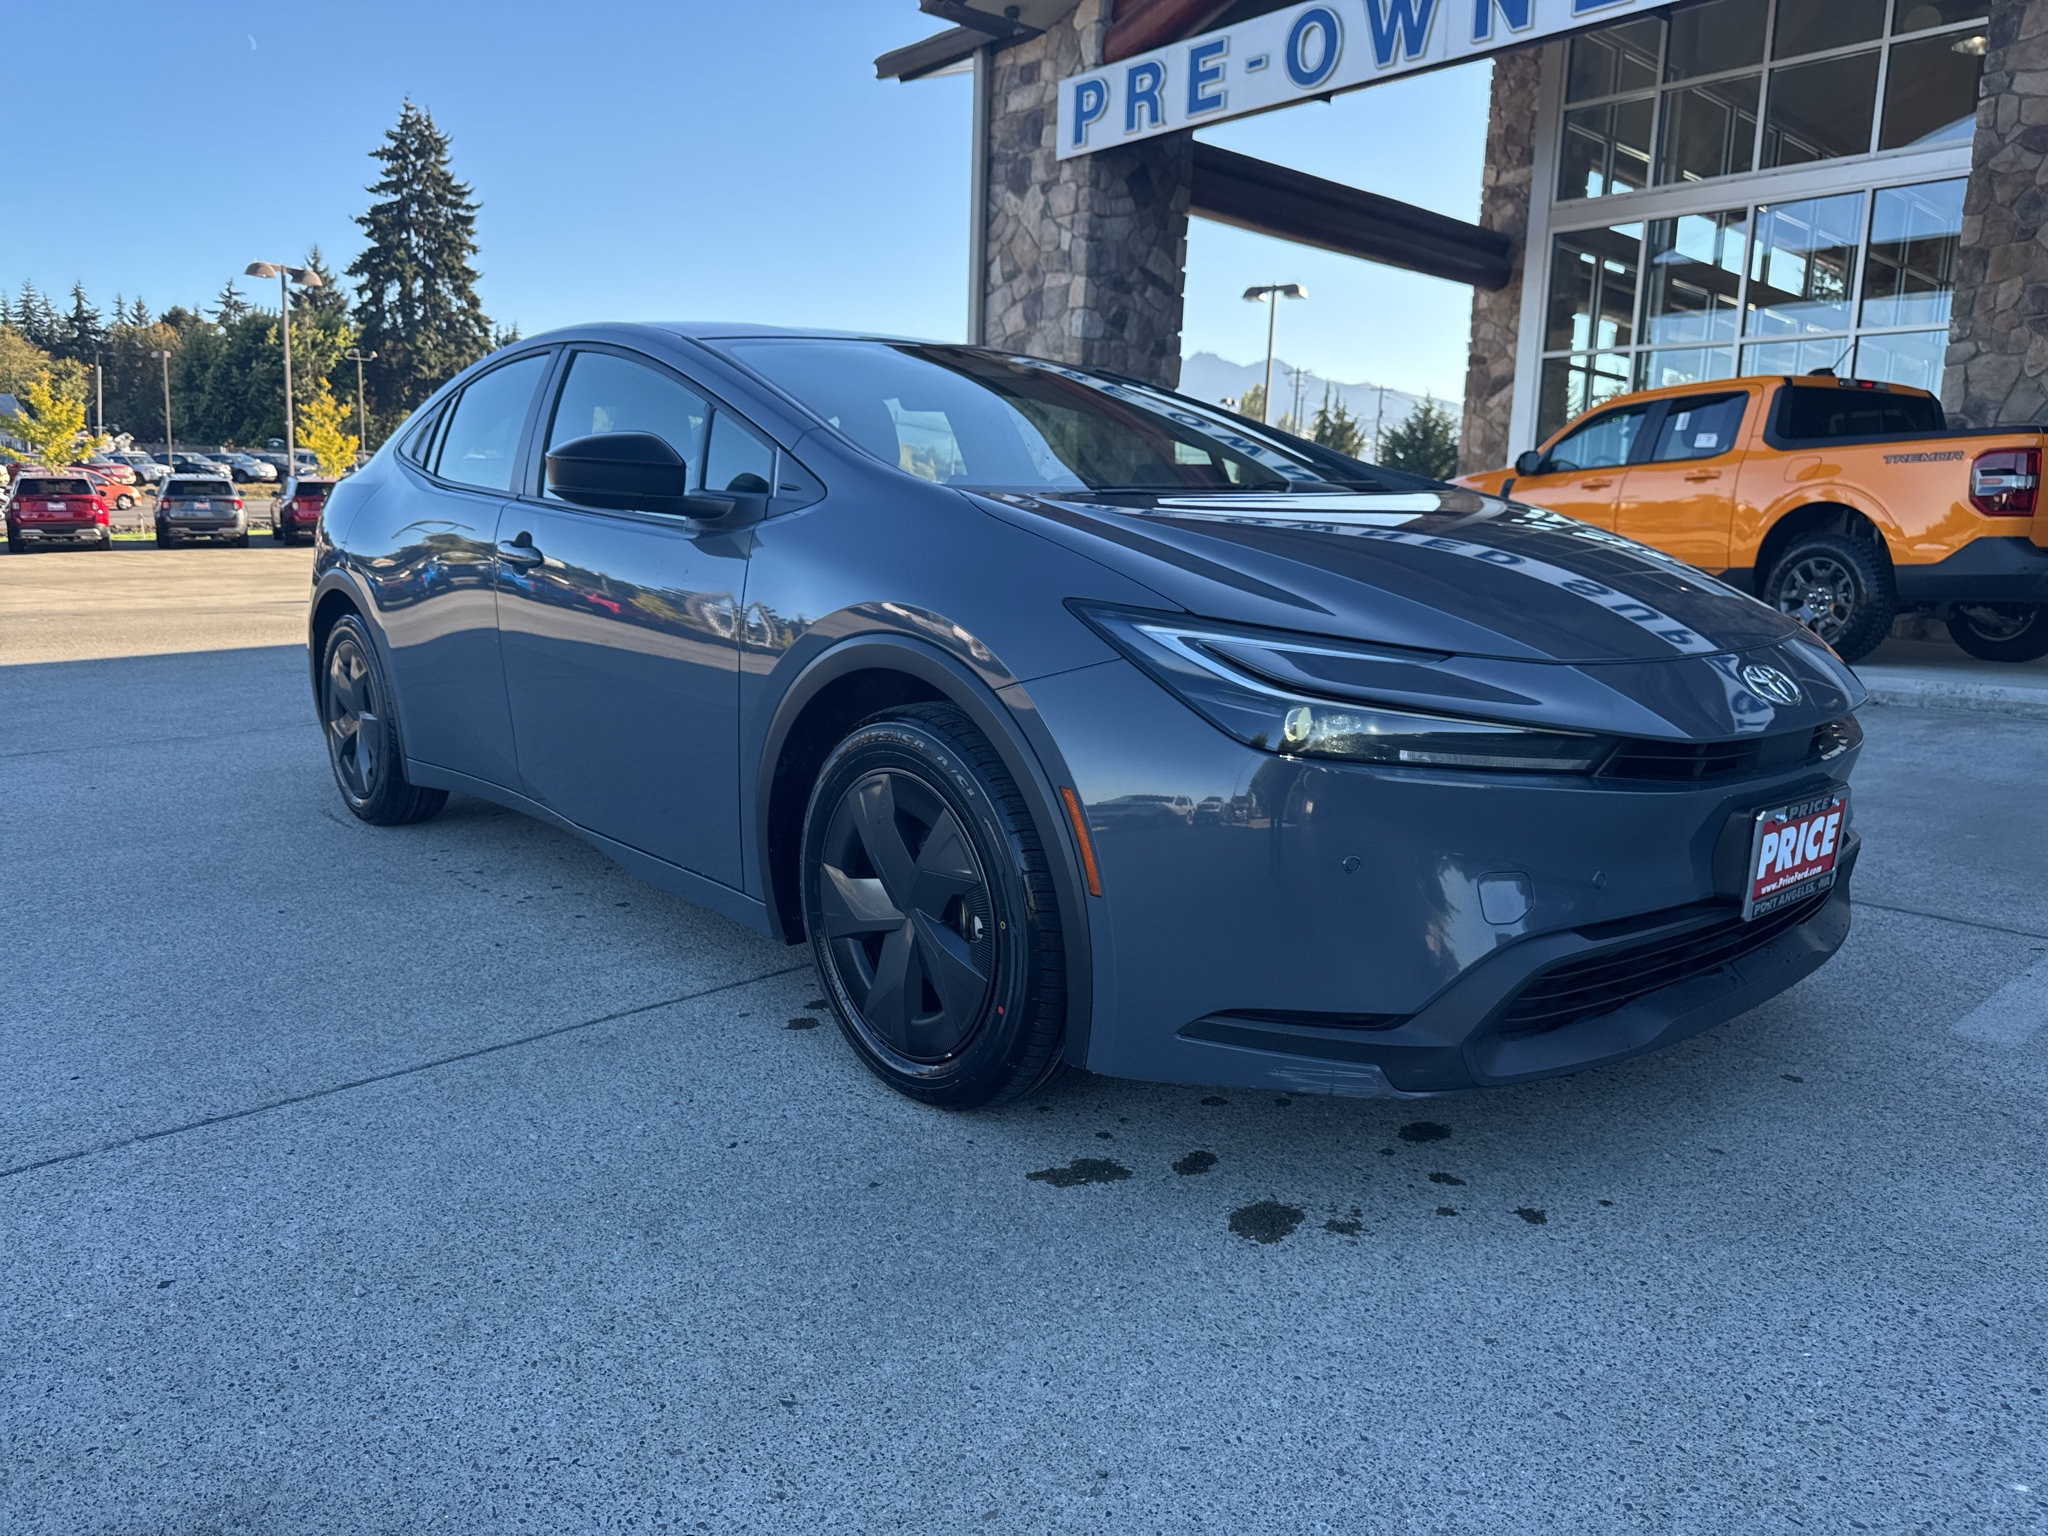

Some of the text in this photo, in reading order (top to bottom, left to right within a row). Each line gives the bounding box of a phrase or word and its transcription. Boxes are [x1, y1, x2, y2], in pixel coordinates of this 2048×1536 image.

[1883, 450, 1965, 464] TREMOR
[1789, 797, 1830, 819] PRICE
[1756, 812, 1841, 880] PRICE
